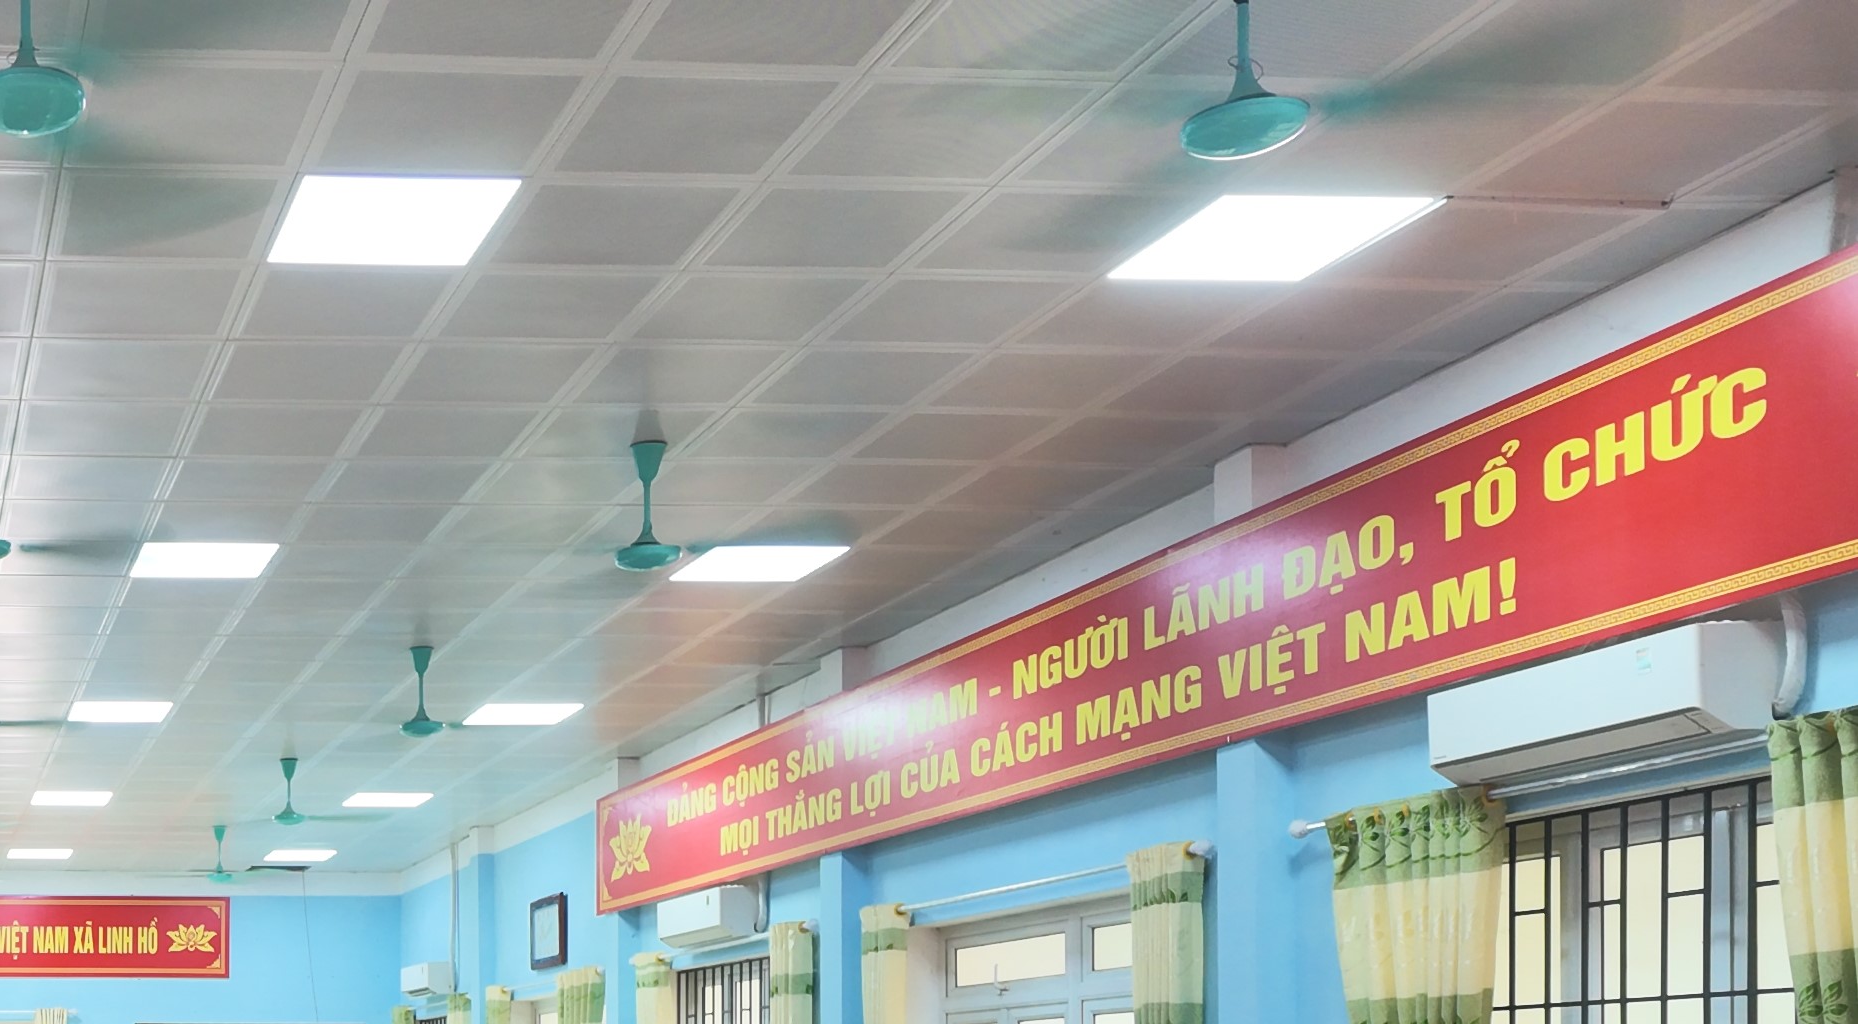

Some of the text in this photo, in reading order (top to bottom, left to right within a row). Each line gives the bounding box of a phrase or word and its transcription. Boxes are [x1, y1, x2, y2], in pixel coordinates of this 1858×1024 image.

[666, 782, 717, 828] ĐẢNG
[722, 764, 779, 807] CỘNG
[785, 731, 834, 782] SẢN
[905, 678, 978, 738] NAM
[1012, 614, 1129, 700] NGƯỜI
[1144, 563, 1264, 651] LÃNH
[1281, 514, 1415, 598] ĐẠO,
[1435, 438, 1520, 543] TỔ
[1542, 366, 1767, 502] CHỨC
[719, 557, 1517, 858] MỌI THẮNG LỢI CỦA CÁCH MẠNG VIỆT NAM!
[33, 925, 69, 954] NAM
[73, 920, 95, 954] XÃ
[98, 926, 133, 954] LINH
[137, 917, 158, 954] HỒ
